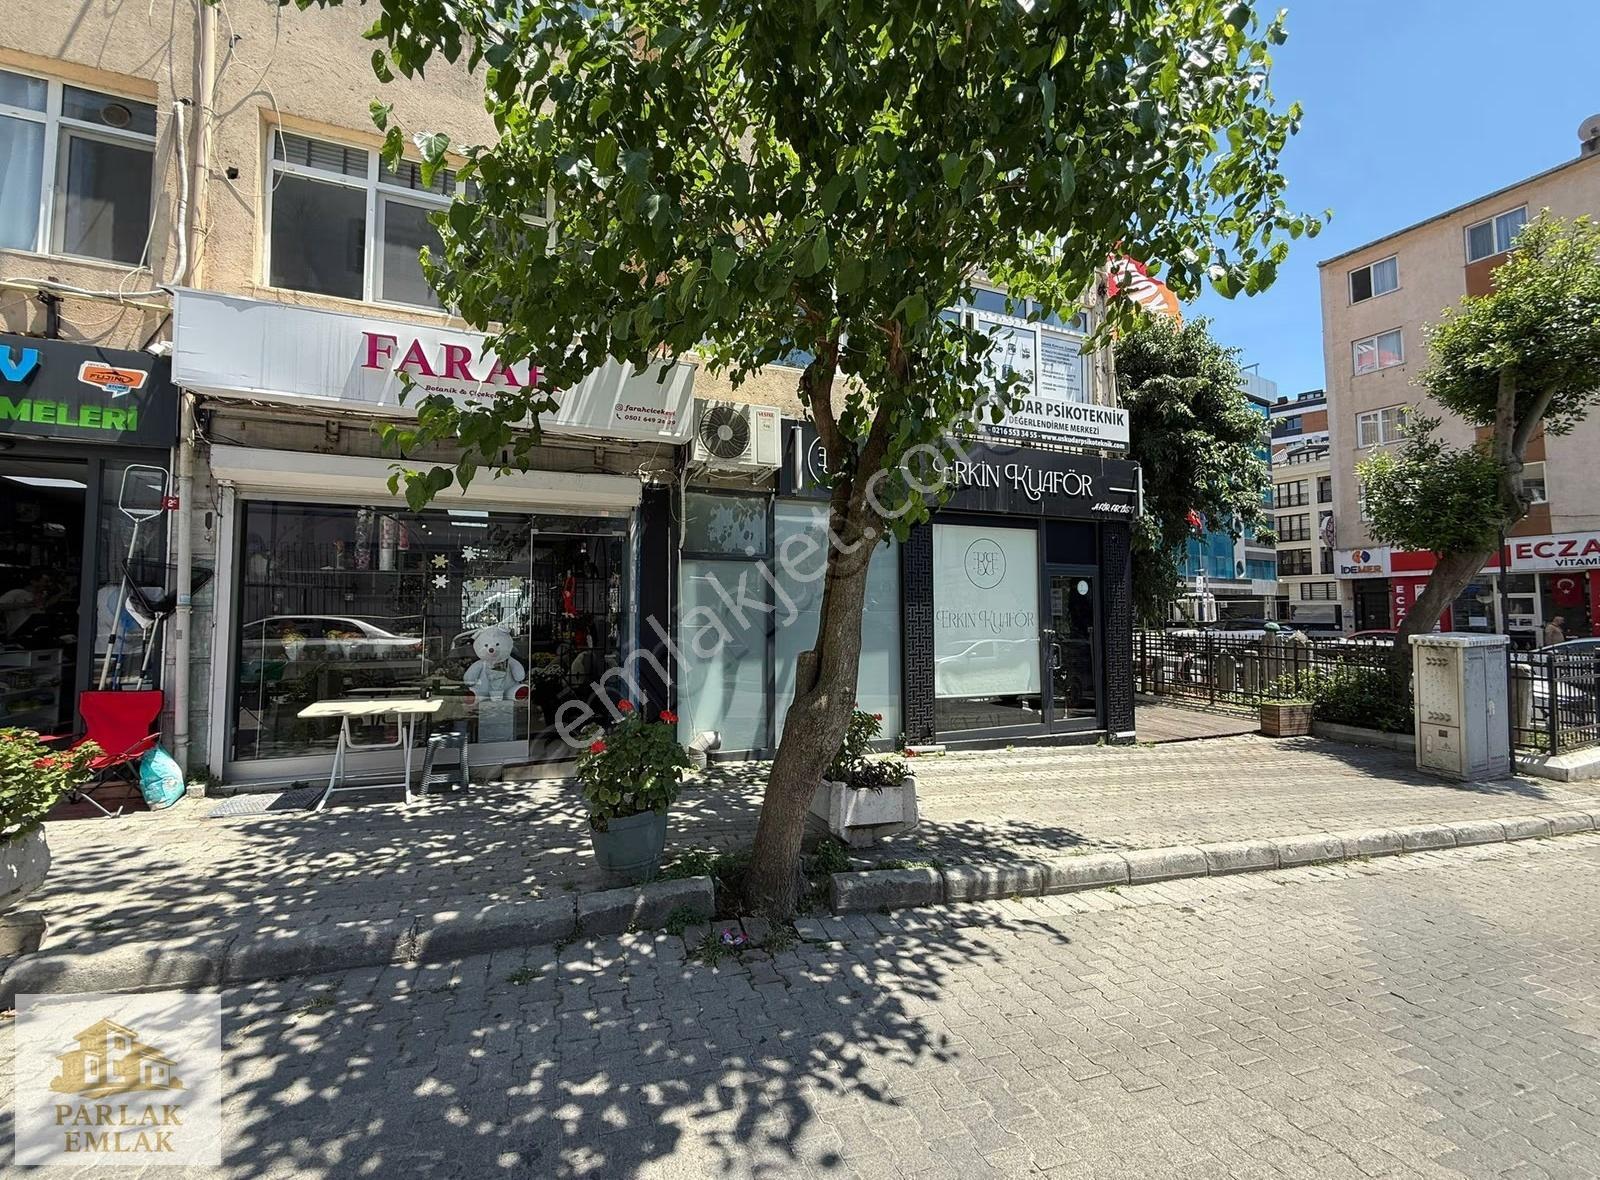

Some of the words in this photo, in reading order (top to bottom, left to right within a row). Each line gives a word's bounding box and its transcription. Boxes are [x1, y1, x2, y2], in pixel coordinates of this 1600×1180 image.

[425, 384, 458, 395] Botanik
[624, 404, 676, 416] farahcicekevi
[624, 414, 641, 422] 0501
[1046, 402, 1125, 427] PSİKOTEKNİK
[991, 426, 1008, 435] 0216
[1008, 428, 1021, 437] 553
[1021, 430, 1029, 438] 34
[1029, 431, 1038, 439] 55
[1008, 414, 1068, 432] DEĞERLENDİRME
[1069, 423, 1100, 435] MERKEZİ
[932, 456, 1000, 488] ERKİN
[1004, 463, 1094, 501] KUAFÖR
[1515, 538, 1600, 560] ECZA
[978, 609, 1035, 635] KUAFÖR
